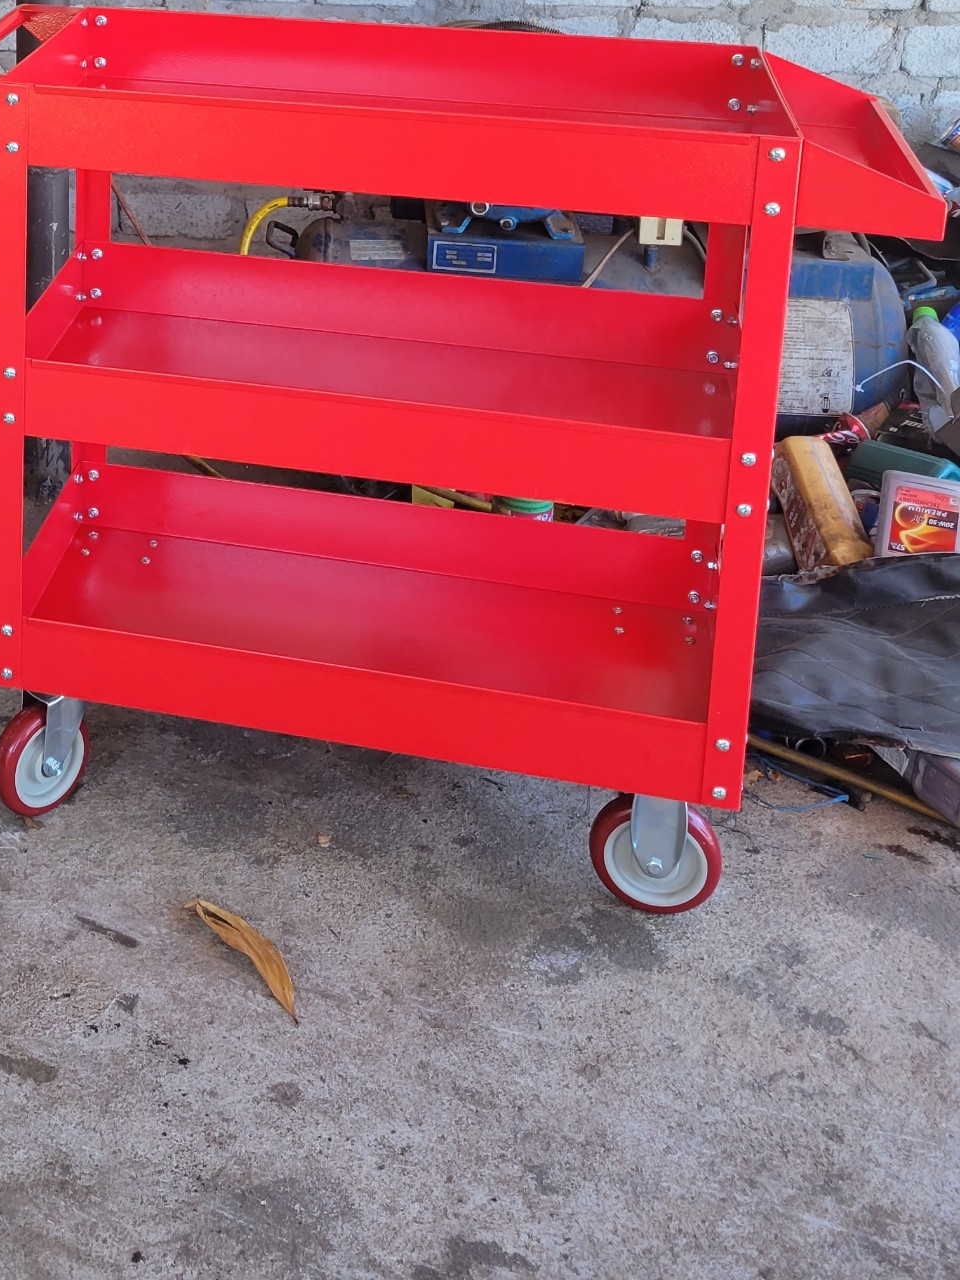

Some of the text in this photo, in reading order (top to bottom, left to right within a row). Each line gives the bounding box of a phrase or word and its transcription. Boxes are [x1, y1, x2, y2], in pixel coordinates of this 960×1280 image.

[898, 496, 940, 508] TECHNOLOGY
[907, 505, 948, 518] PREMIUM
[928, 518, 955, 529] 20W-50
